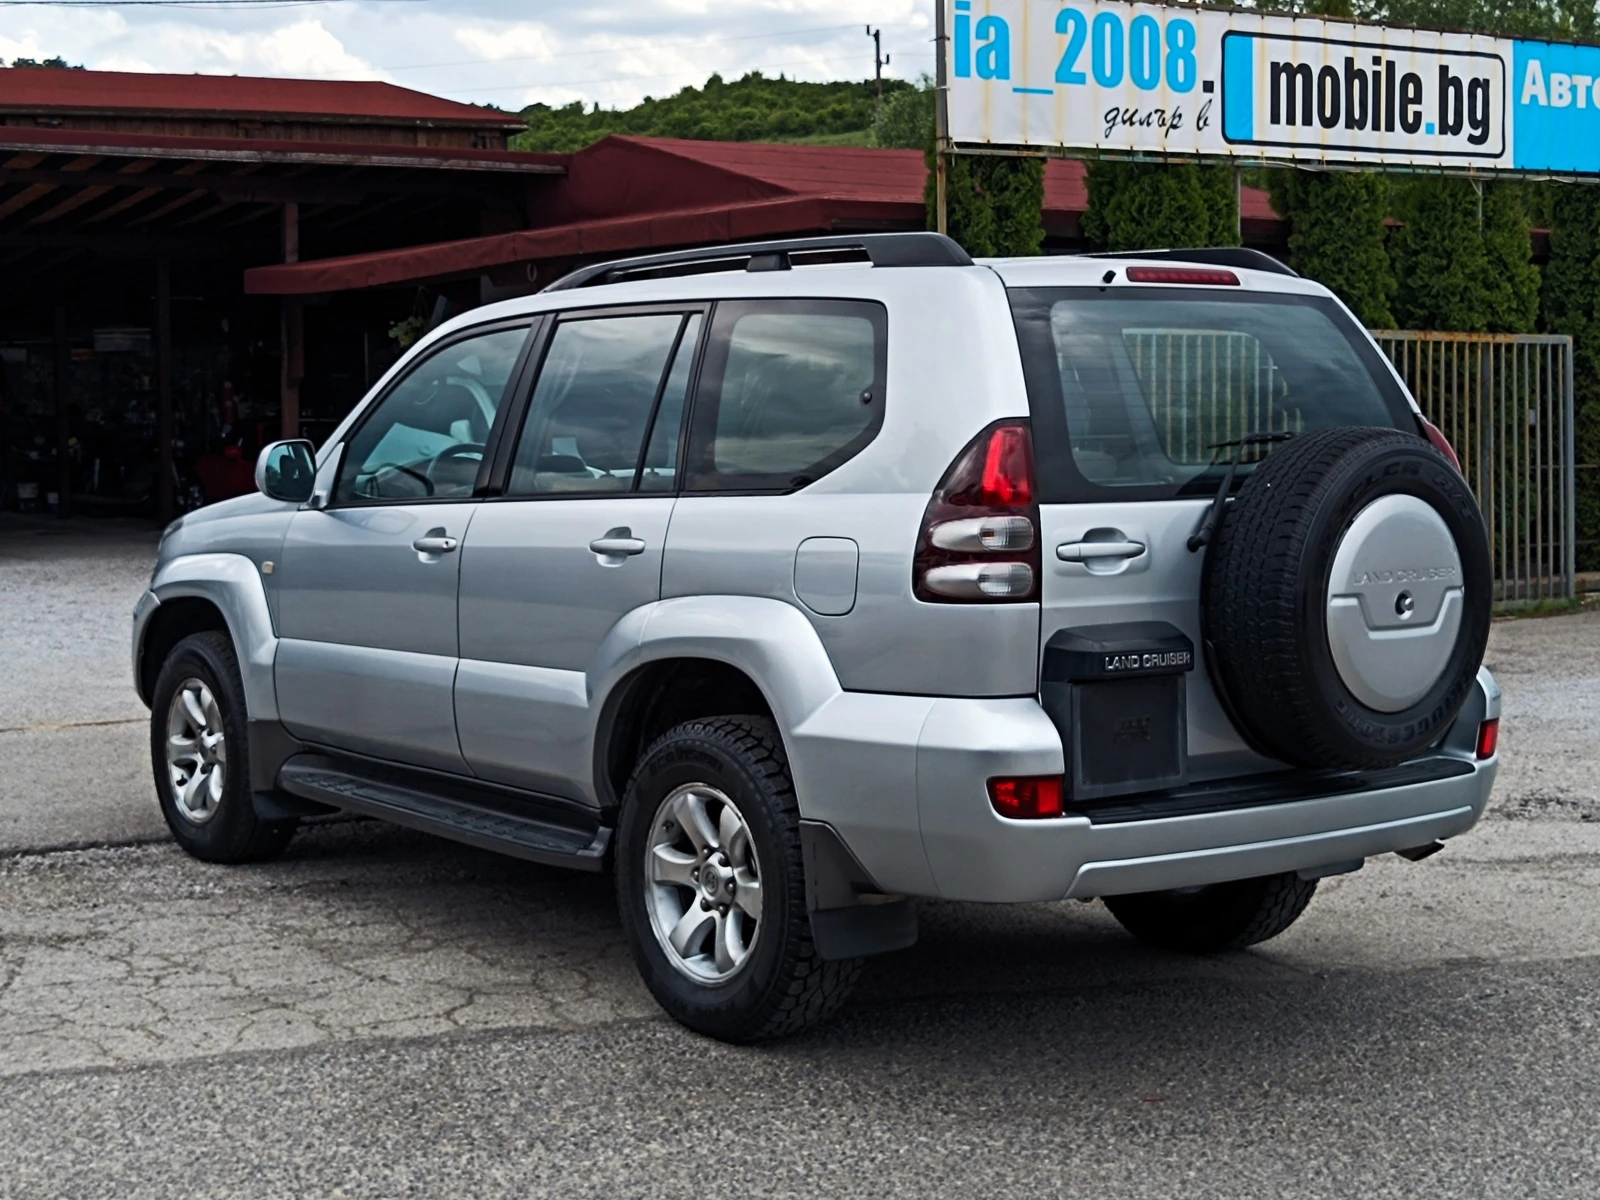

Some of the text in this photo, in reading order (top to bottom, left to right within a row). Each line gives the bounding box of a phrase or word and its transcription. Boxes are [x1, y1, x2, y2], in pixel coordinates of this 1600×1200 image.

[1269, 55, 1490, 145] mobile.bg
[1103, 105, 1184, 138] дилър
[1352, 565, 1457, 587] LAND CRUISER
[1104, 651, 1191, 671] LAND CRUISER
